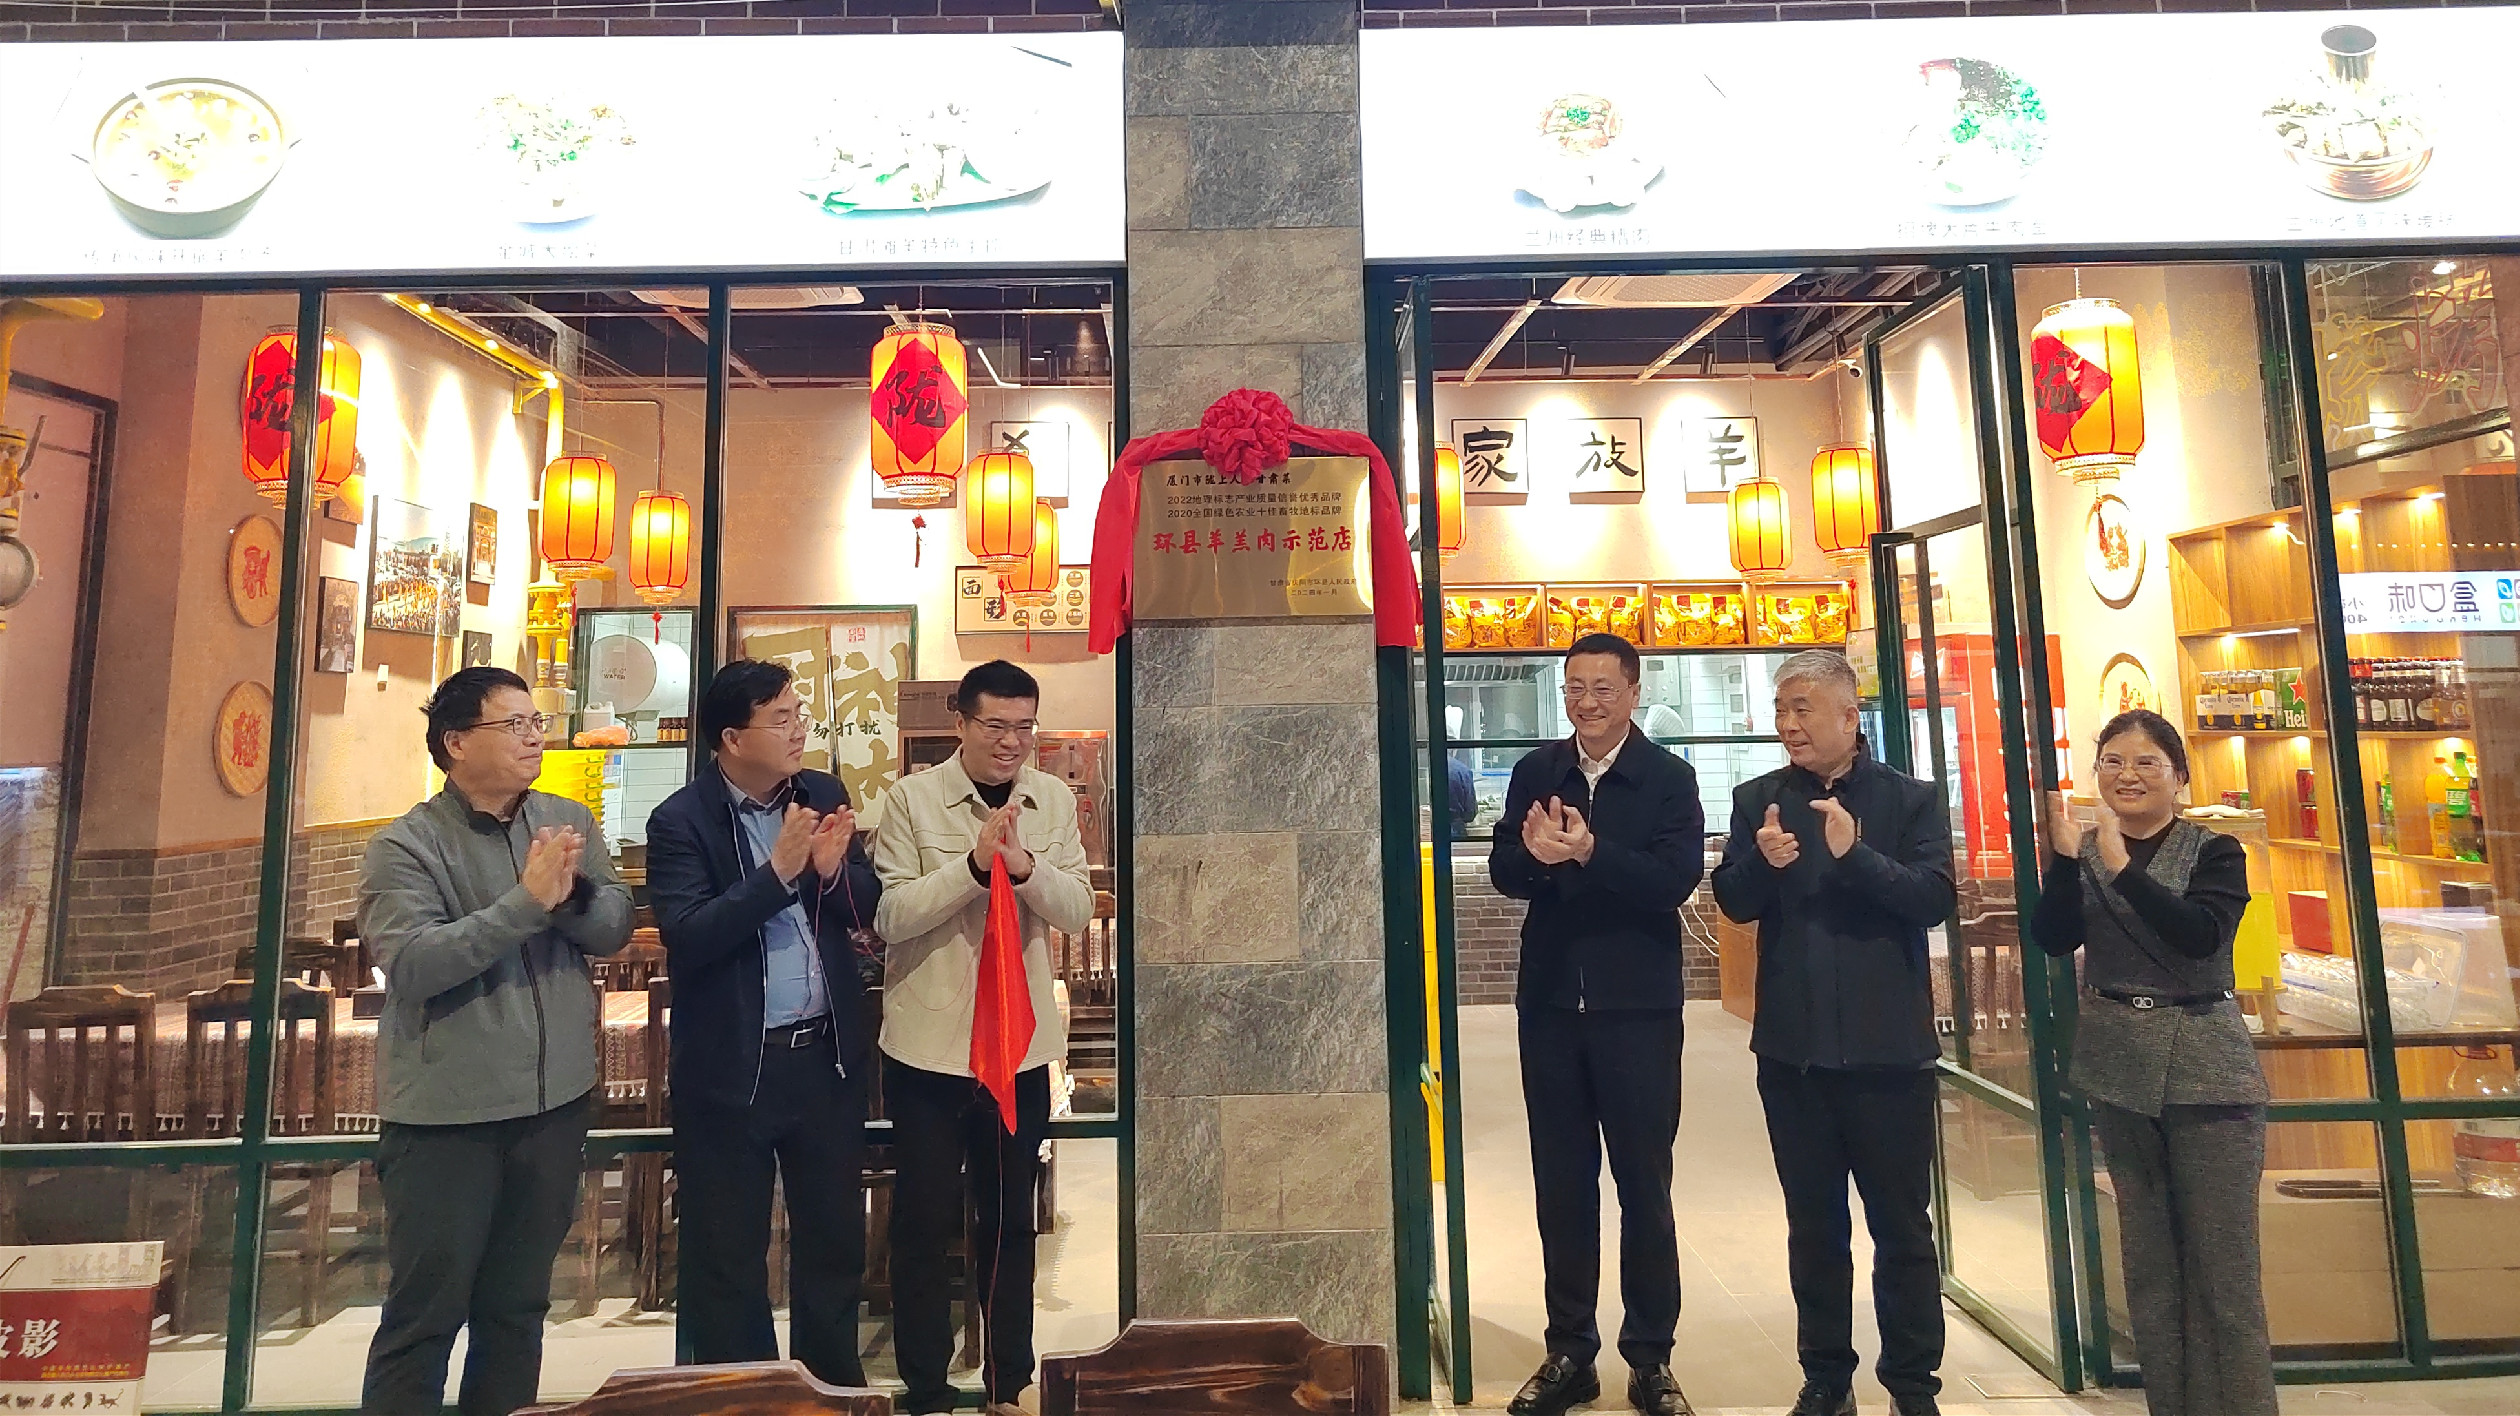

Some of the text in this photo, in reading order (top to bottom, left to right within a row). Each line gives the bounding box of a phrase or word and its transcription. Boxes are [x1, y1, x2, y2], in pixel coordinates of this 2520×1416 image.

[885, 365, 946, 428] 陇
[1167, 473, 1292, 487] 厦门市陇上人甘肃菜
[1153, 525, 1352, 554] 环县羊羔肉示范店
[2284, 709, 2308, 727] Hei
